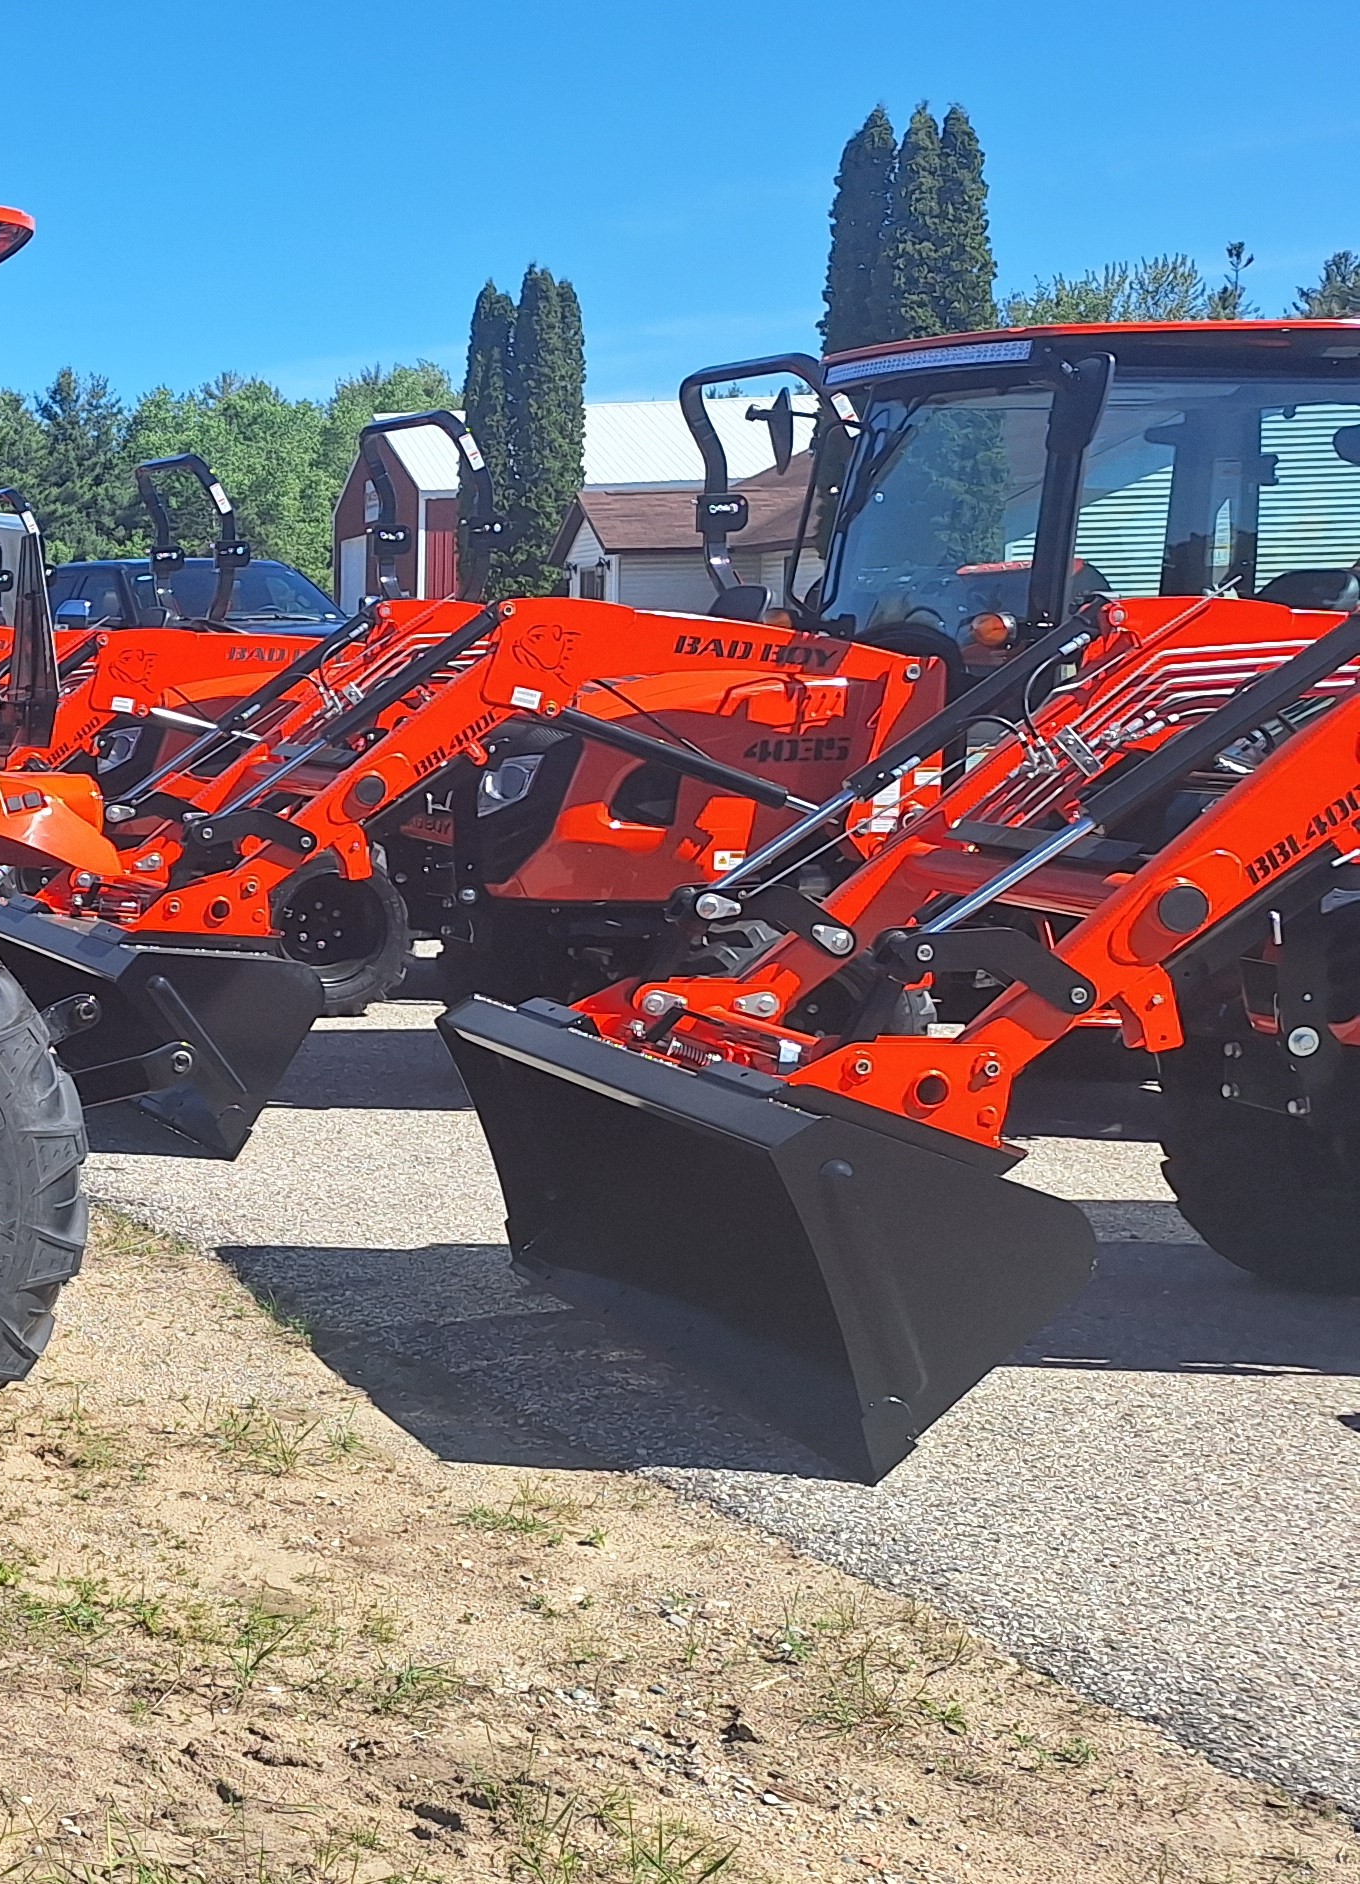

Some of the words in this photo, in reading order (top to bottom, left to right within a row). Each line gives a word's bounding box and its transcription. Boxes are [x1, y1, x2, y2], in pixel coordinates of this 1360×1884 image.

[228, 646, 287, 663] BAD
[674, 635, 753, 660] BAD
[760, 643, 838, 668] BOY
[742, 737, 851, 763] 4035
